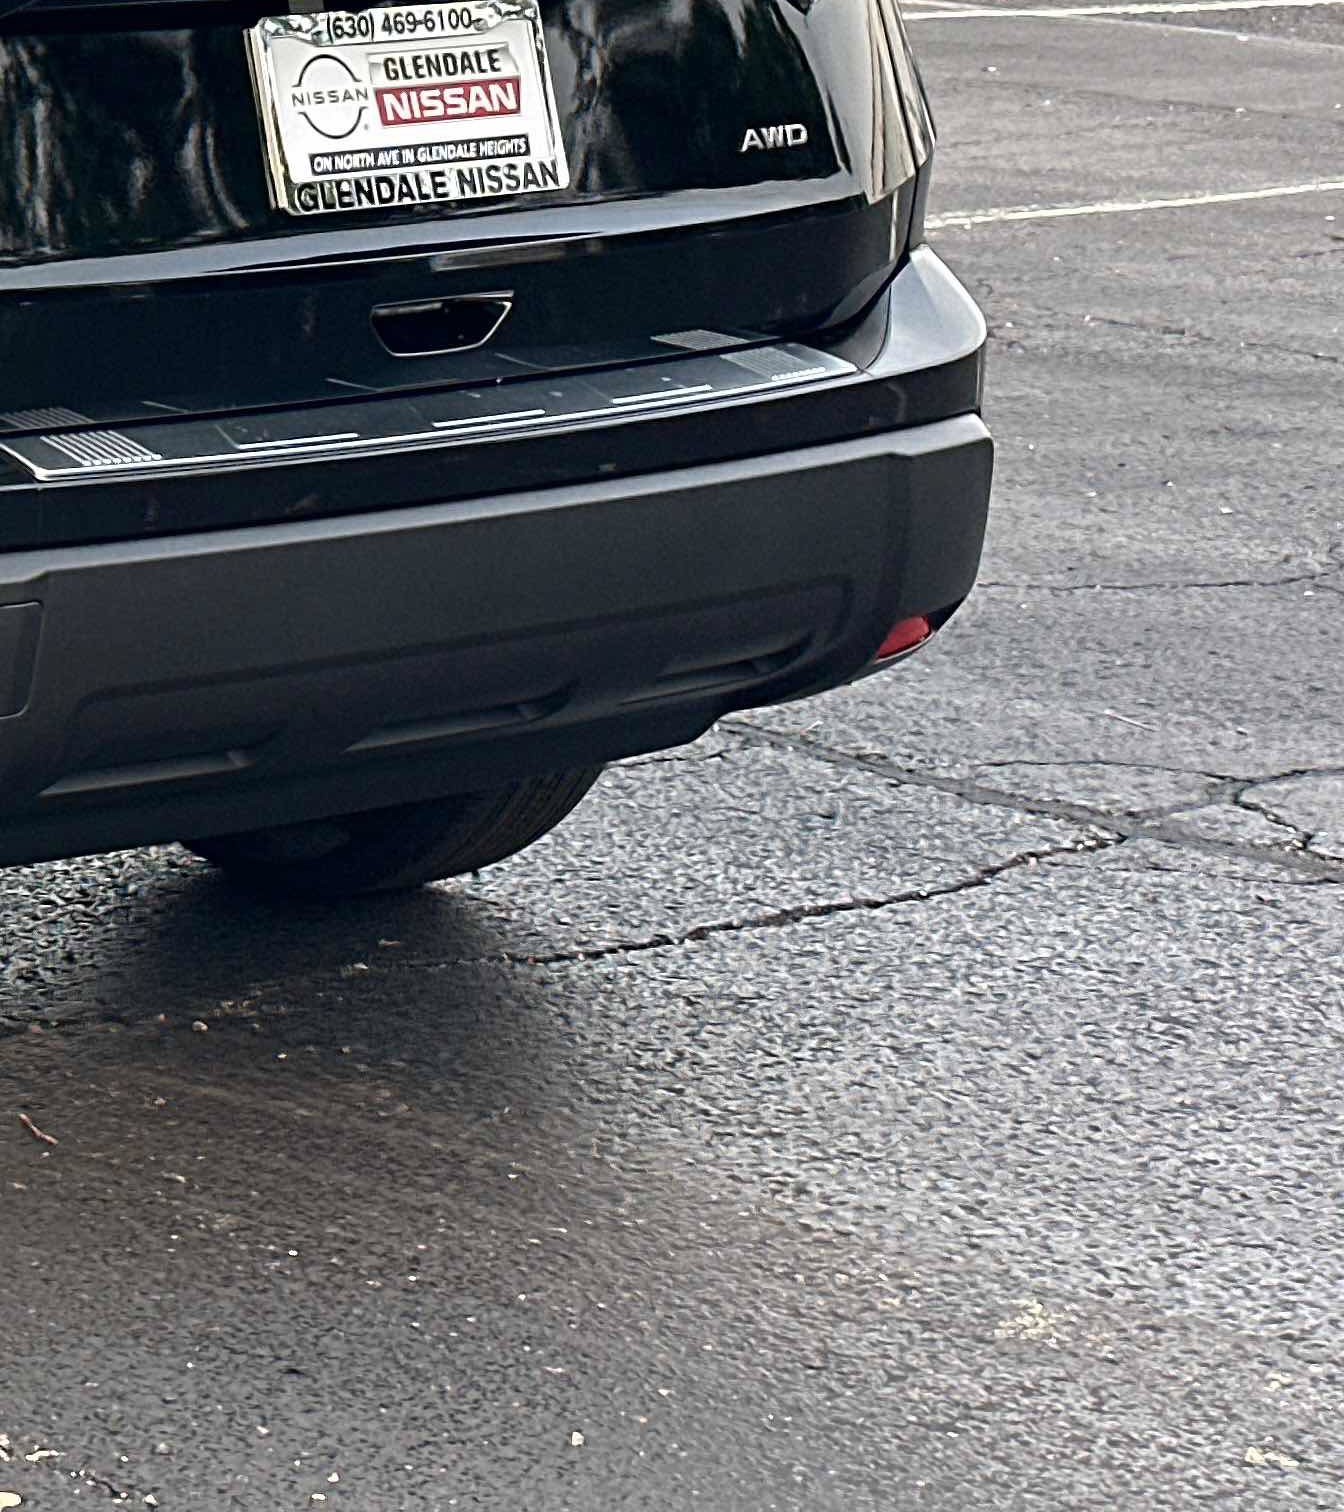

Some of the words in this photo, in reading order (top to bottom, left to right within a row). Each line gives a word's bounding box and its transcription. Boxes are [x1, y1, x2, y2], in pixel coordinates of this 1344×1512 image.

[326, 12, 375, 43] (630)
[381, 7, 473, 36] 469-6100
[383, 47, 502, 81] GLENDALE
[291, 87, 369, 107] NISSAN
[382, 81, 518, 121] NISSAN
[313, 155, 332, 173] ON
[334, 152, 375, 171] NORTH
[377, 150, 400, 167] AVE
[402, 148, 414, 164] IN
[417, 142, 477, 163] GLENDALE
[479, 137, 527, 157] HEIGHTS
[738, 123, 808, 152] AWD
[297, 170, 451, 213] GLENDALE
[455, 159, 560, 197] NISSAN
